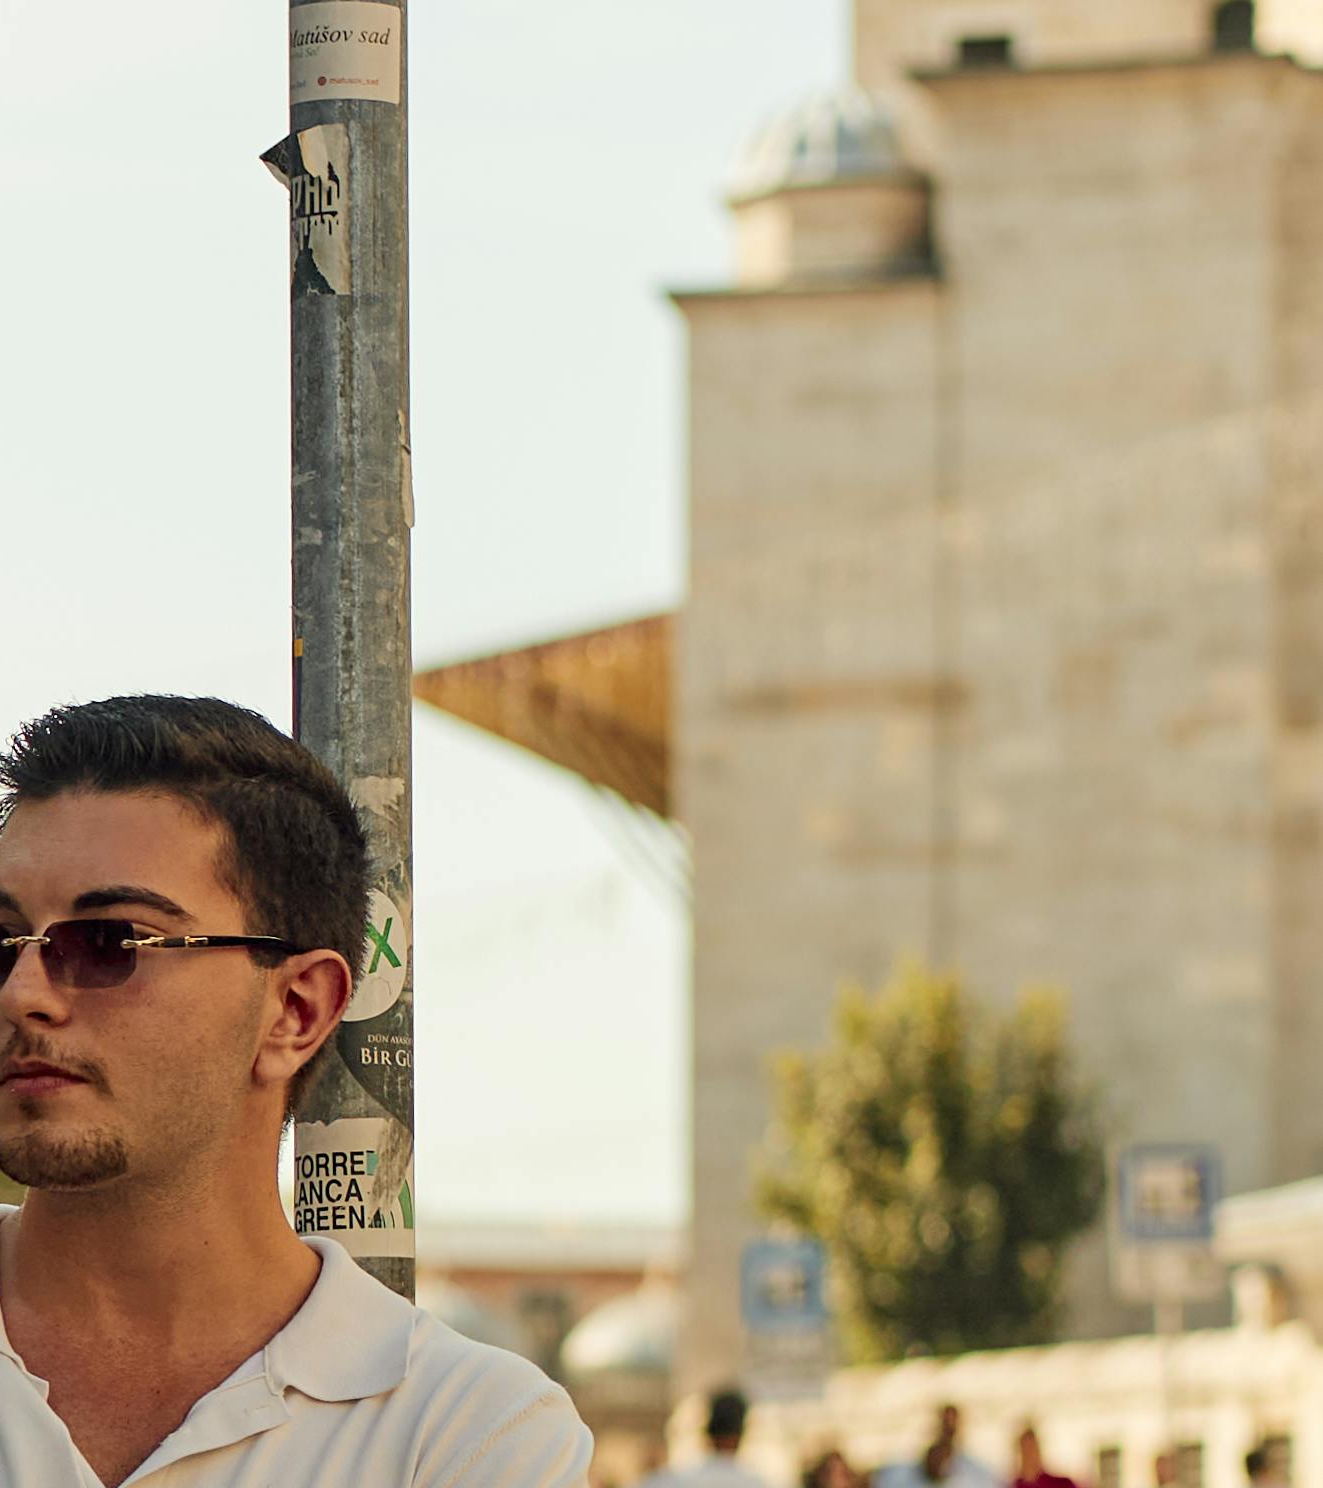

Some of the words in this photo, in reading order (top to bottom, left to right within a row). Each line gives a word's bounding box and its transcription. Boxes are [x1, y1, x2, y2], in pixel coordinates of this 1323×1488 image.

[358, 28, 391, 45] sad
[361, 1046, 392, 1066] BİR
[295, 1205, 365, 1233] GREEN
